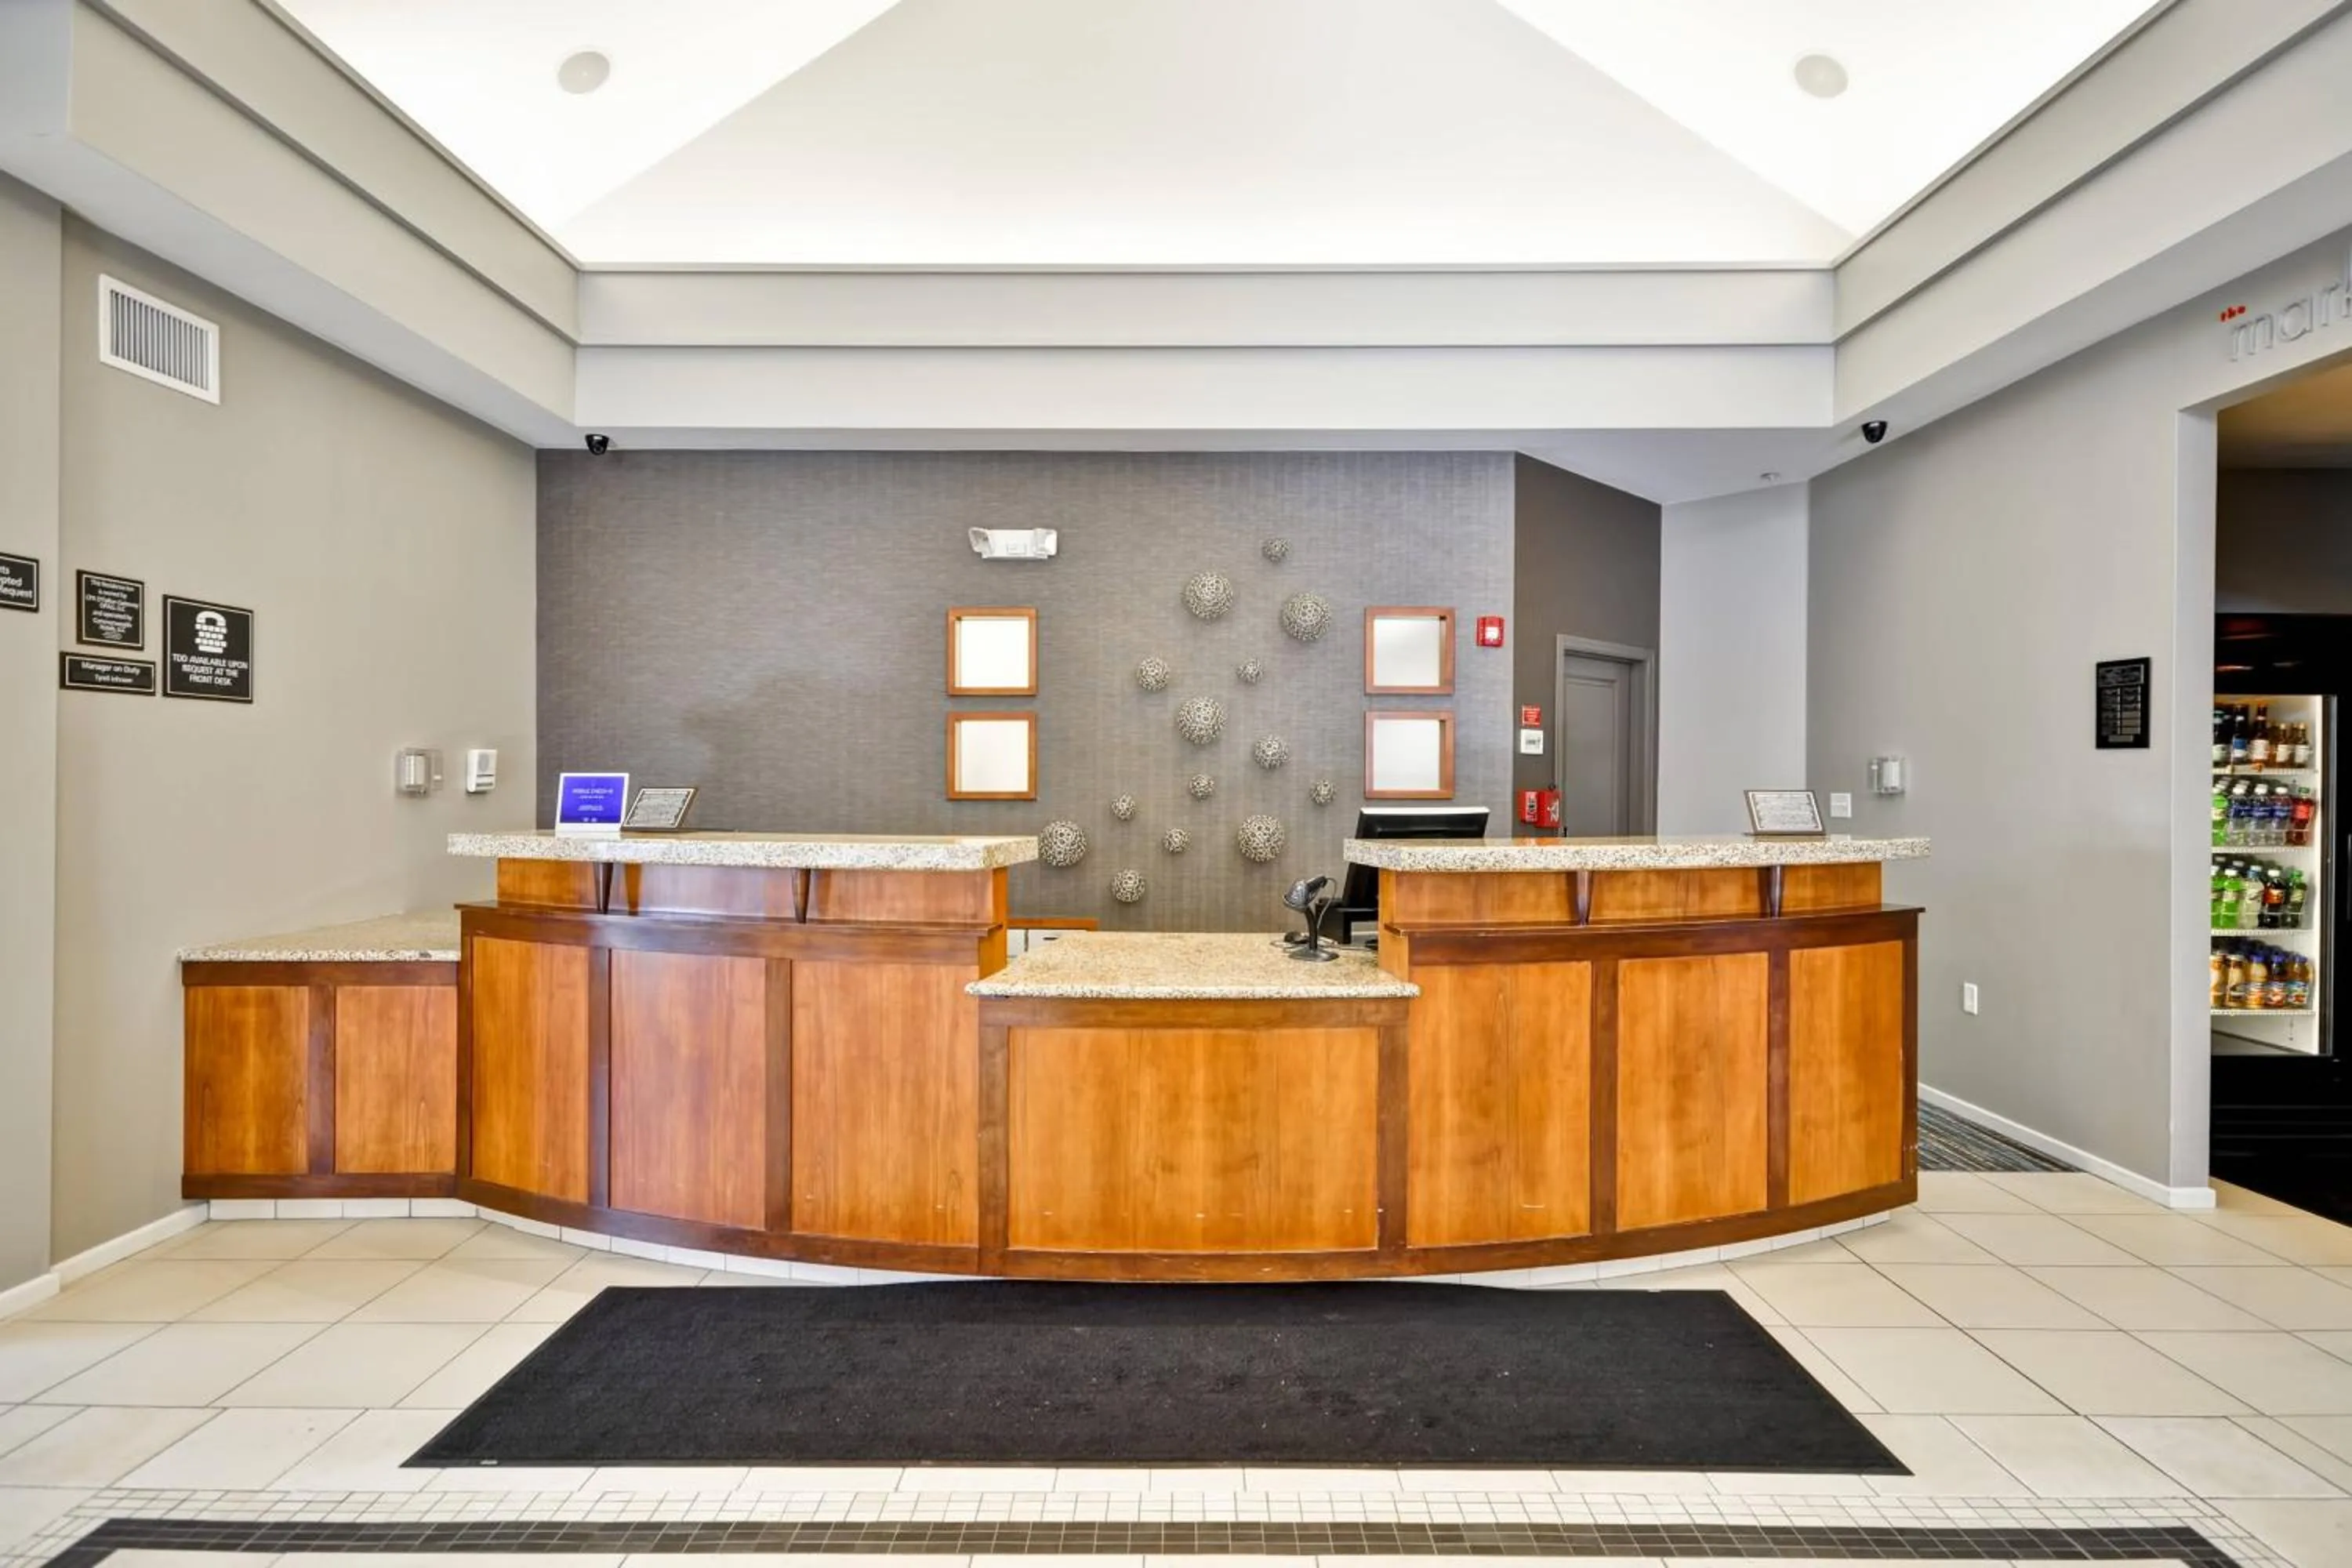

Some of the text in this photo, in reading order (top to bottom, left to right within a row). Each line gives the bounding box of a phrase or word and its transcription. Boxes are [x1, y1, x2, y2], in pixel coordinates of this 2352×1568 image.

[81, 661, 111, 673] Manager
[123, 665, 140, 676] Duty
[172, 653, 249, 670] TDD AVAILABLE UPON
[182, 664, 238, 678] REQUEST AT THE
[189, 673, 233, 686] FRONT DESK
